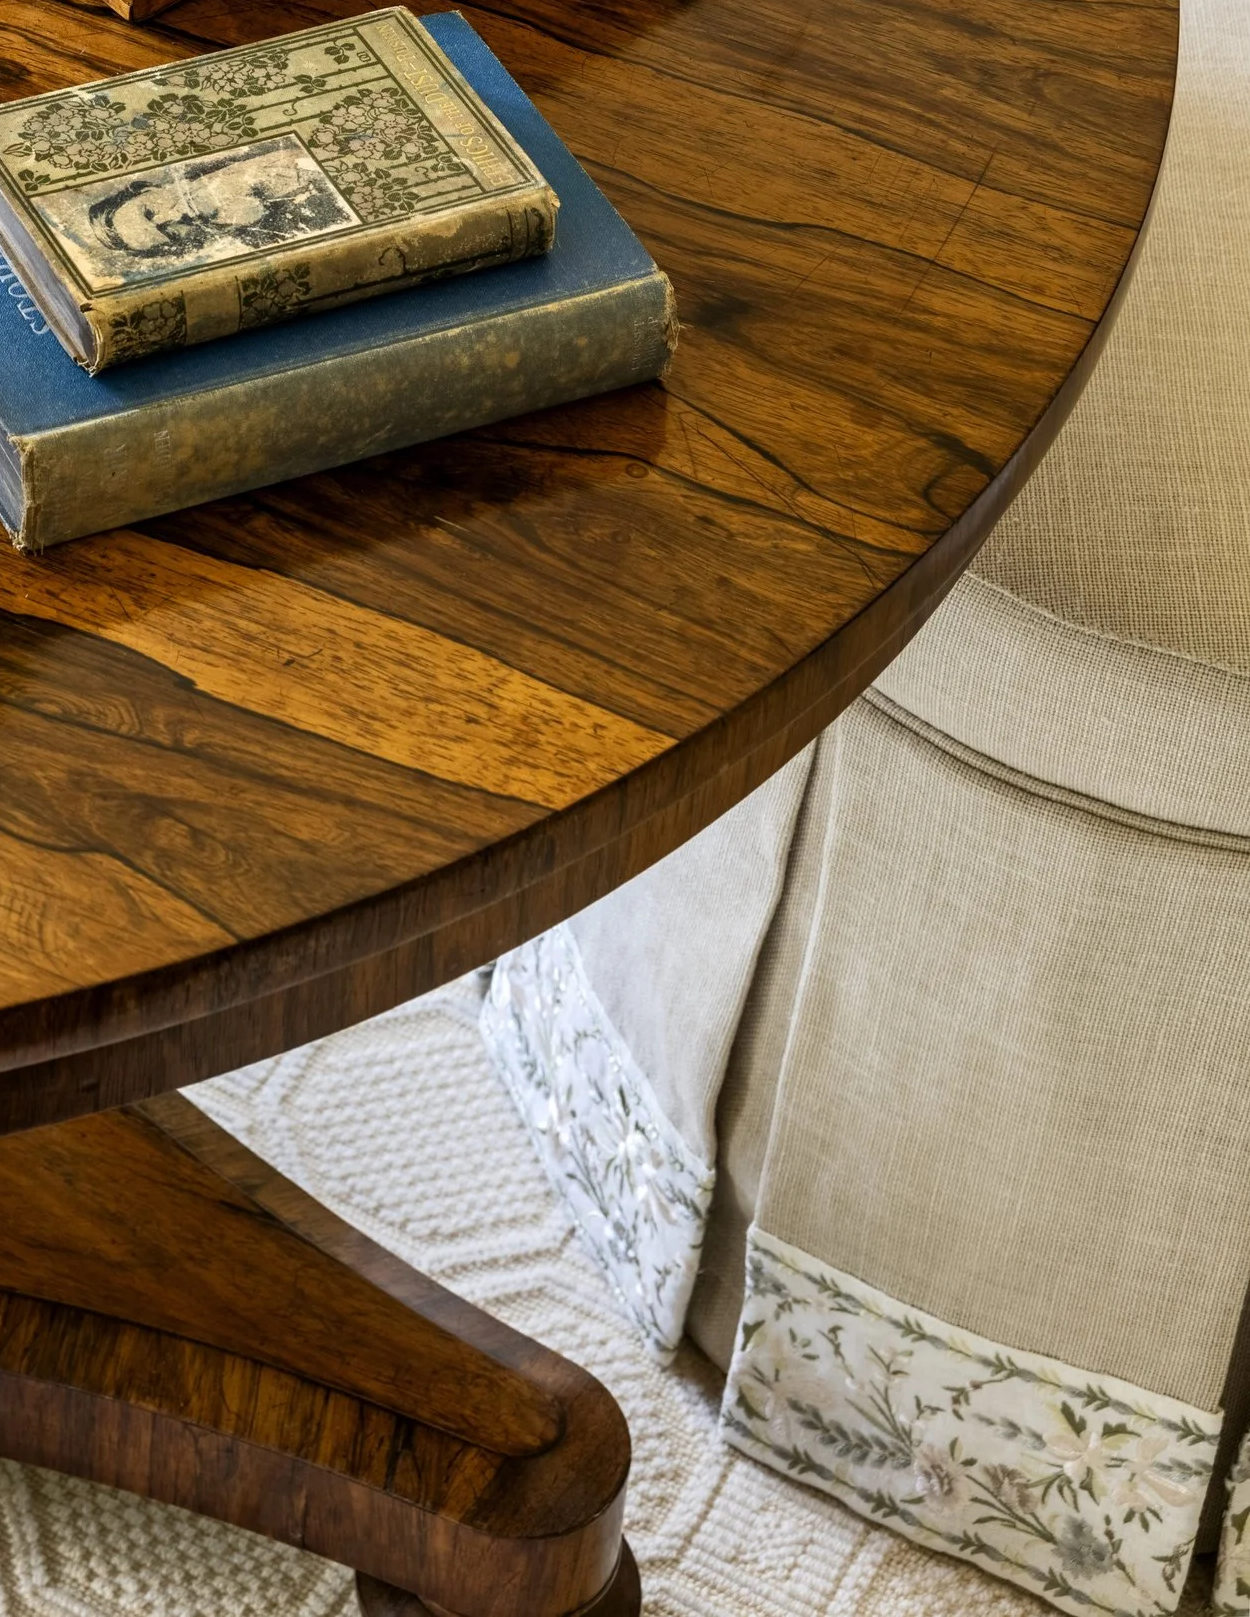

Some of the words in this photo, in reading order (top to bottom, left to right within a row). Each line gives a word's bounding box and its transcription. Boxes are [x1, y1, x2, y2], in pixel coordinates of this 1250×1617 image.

[403, 67, 449, 105] DUST
[439, 101, 465, 121] THE
[455, 122, 475, 135] OF
[459, 136, 515, 187] ETHICS
